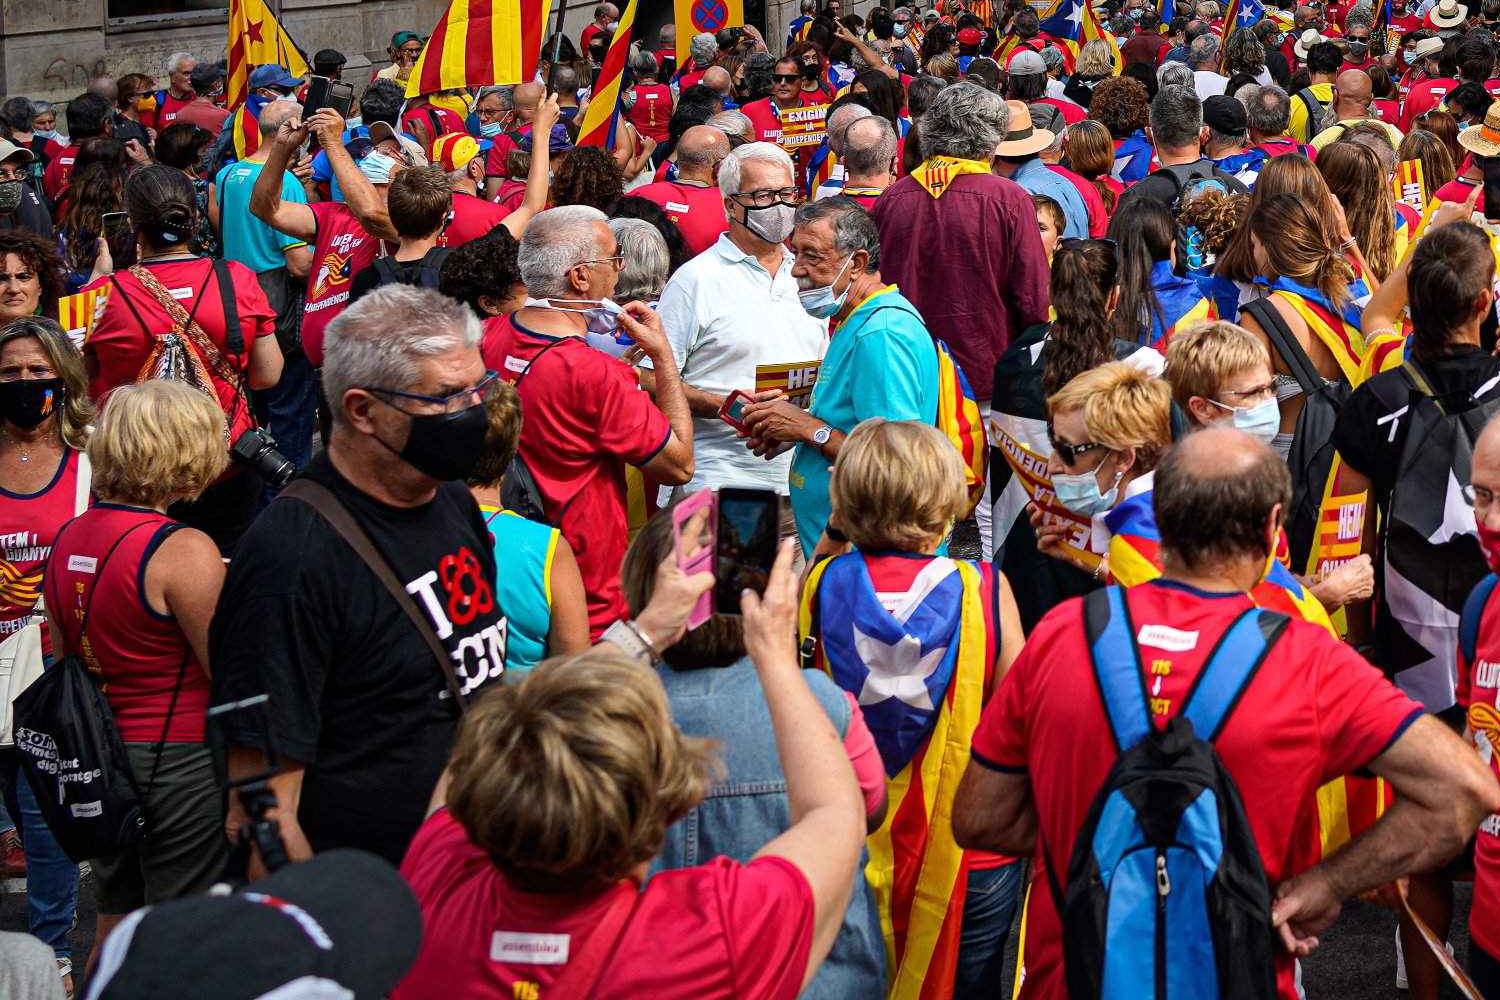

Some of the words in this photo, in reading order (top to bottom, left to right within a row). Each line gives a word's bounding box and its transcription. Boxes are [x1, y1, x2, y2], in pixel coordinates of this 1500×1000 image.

[805, 122, 814, 131] LA
[785, 131, 827, 145] INDEPENDÈN
[787, 367, 821, 389] HE
[1033, 483, 1056, 507] LA
[1337, 502, 1362, 540] HEM
[0, 531, 29, 550] TEM
[6, 546, 52, 562] GUANY
[406, 571, 454, 641] I
